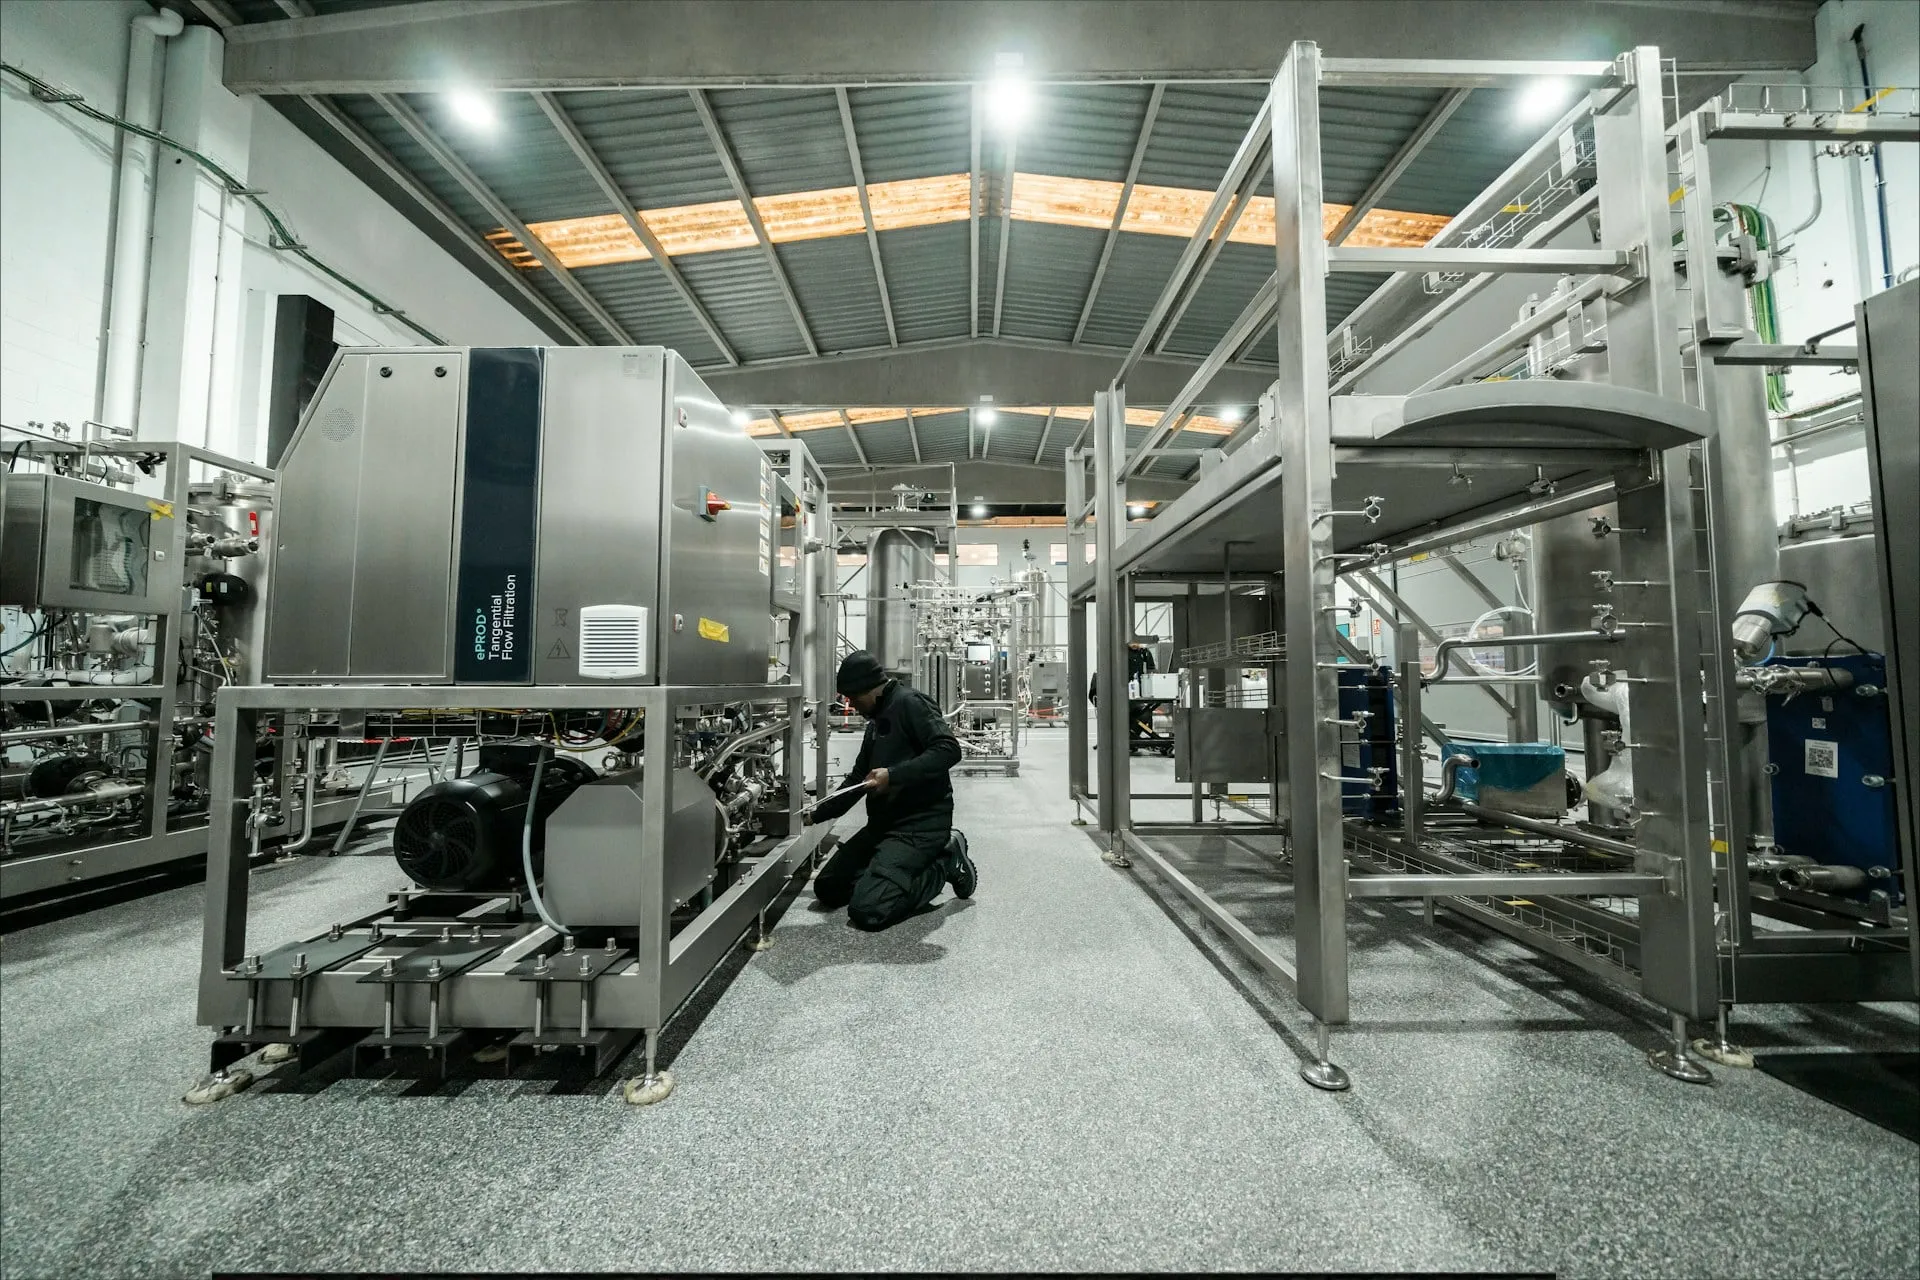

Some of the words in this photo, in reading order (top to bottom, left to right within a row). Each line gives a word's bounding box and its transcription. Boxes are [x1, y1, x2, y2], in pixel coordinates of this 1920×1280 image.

[503, 574, 517, 627] Filtration
[488, 594, 503, 661] Tangential
[501, 630, 514, 661] Flow
